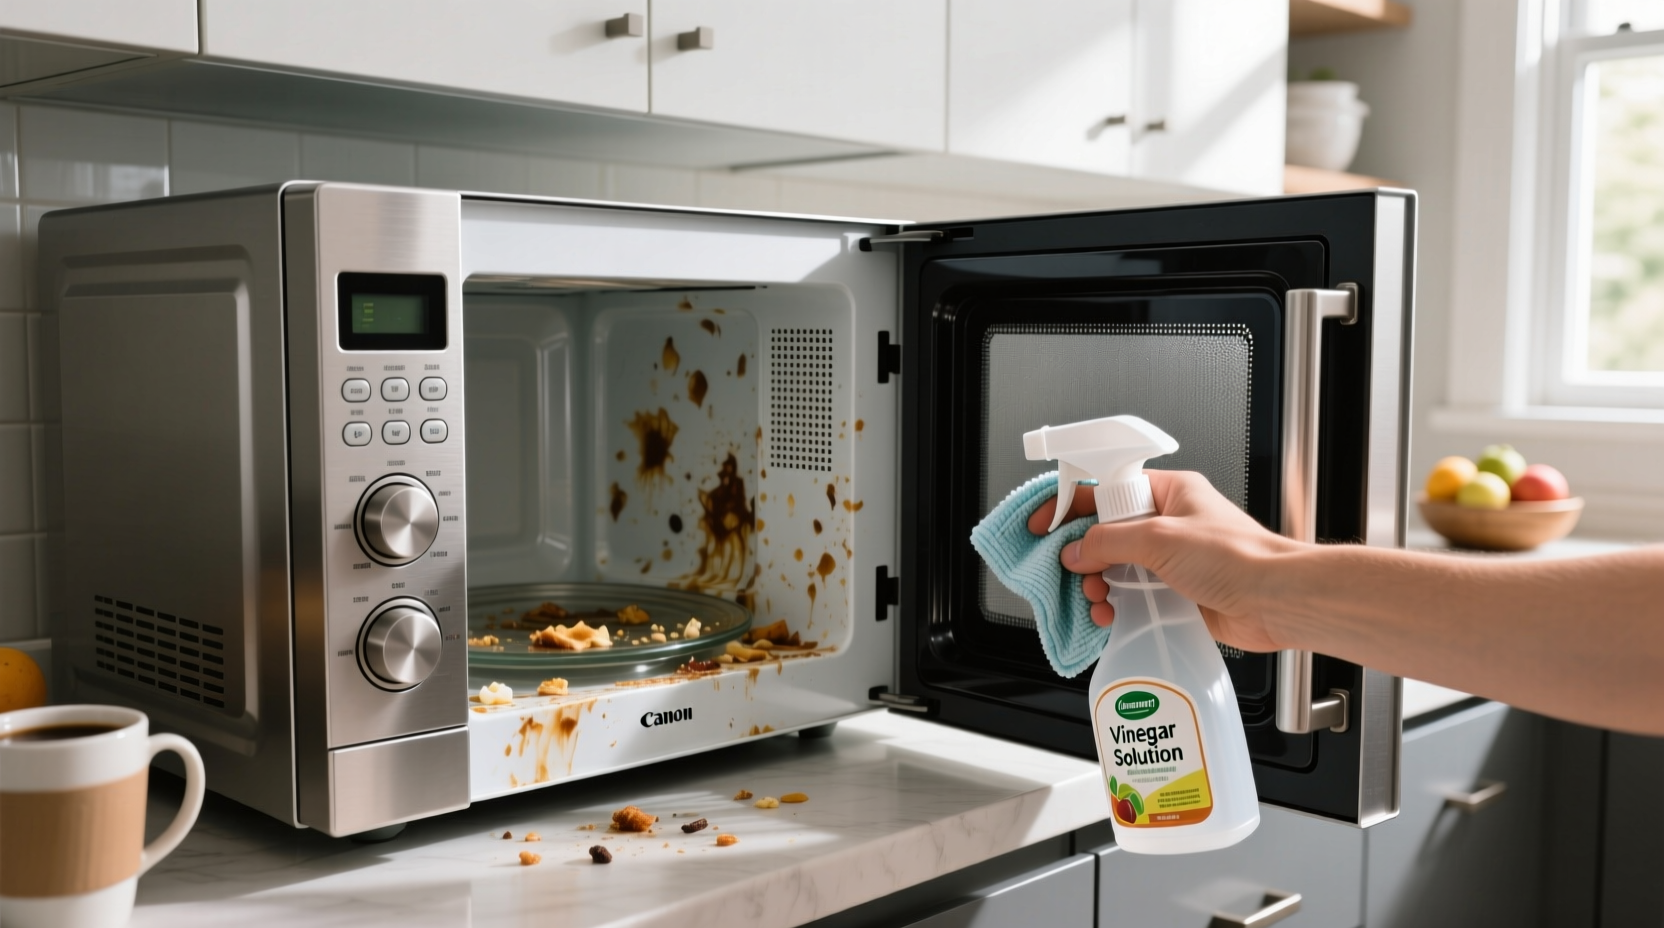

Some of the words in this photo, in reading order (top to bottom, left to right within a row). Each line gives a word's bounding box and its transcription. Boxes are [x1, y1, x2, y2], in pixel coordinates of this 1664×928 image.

[640, 707, 692, 728] Canon
[1109, 723, 1176, 746] Vinegar
[1114, 745, 1183, 767] Solution
